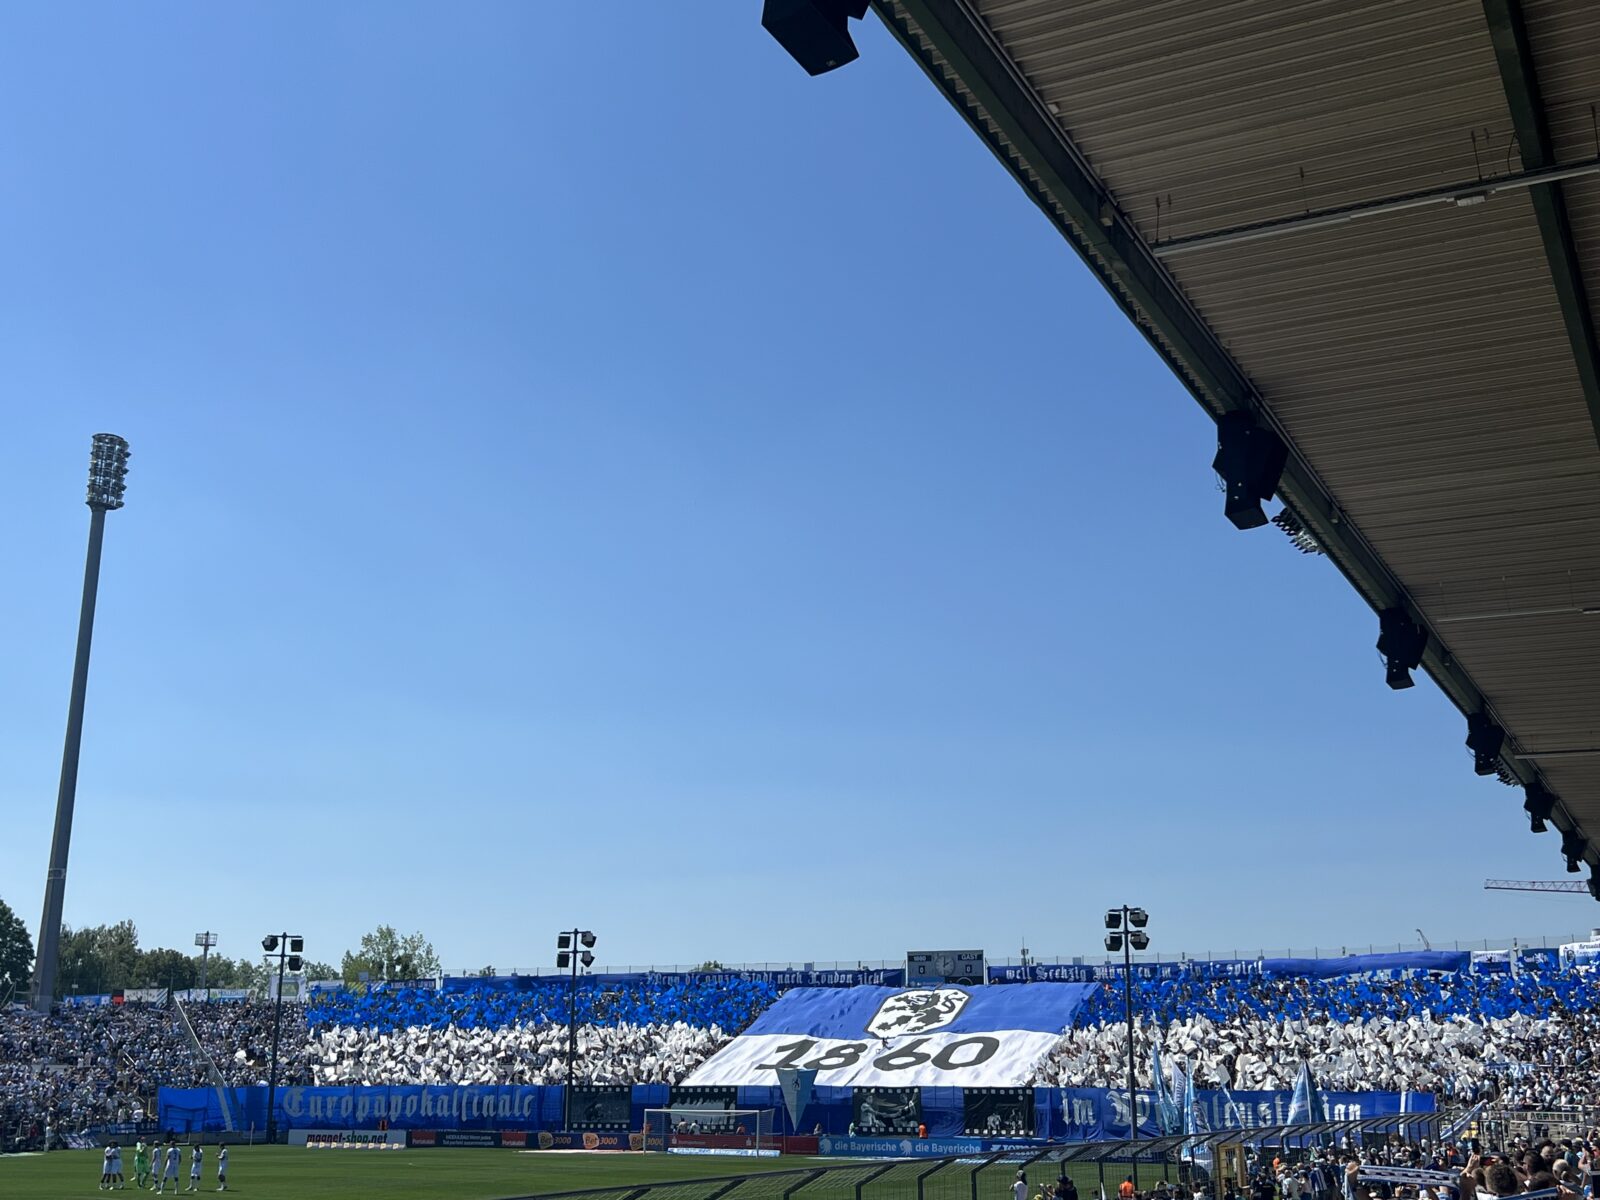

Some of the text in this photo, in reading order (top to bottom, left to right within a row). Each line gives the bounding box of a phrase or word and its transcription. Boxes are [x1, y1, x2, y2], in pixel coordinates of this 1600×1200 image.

[777, 971, 803, 985] nach
[807, 971, 853, 986] London
[754, 1035, 1000, 1071] 1860
[282, 1085, 535, 1123] Europapokalfinale
[834, 1140, 897, 1152] die Bayerische
[915, 1142, 981, 1154] die Bayerische
